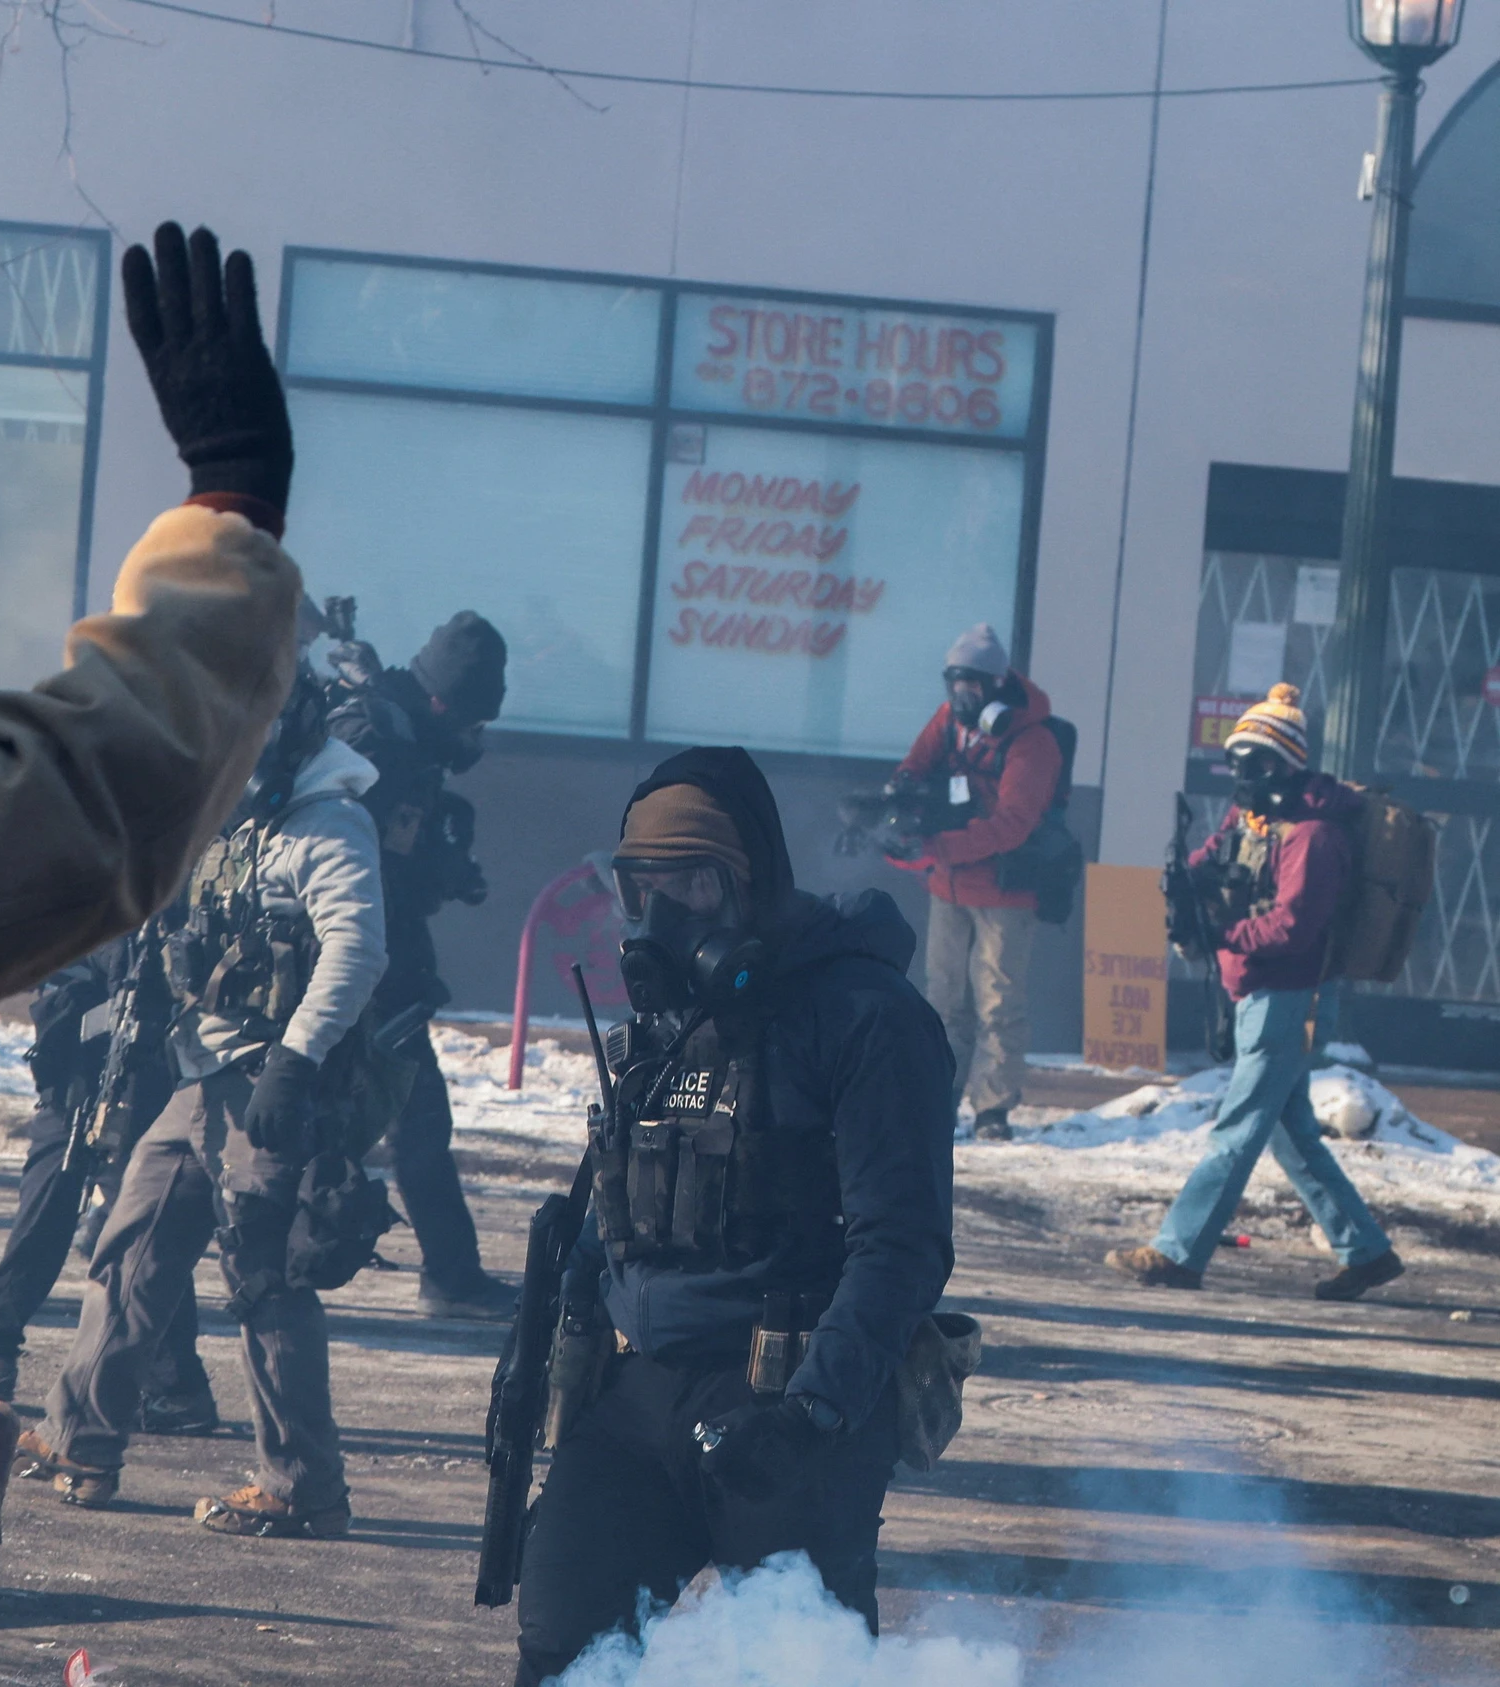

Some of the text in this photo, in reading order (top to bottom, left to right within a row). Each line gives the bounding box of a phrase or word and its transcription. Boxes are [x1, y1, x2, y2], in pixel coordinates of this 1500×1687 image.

[707, 305, 1006, 384] STORE HOURS
[682, 470, 861, 518] MONDAY
[678, 515, 848, 562] FRIDAY
[670, 560, 887, 613] SATURDAY
[668, 607, 847, 657] SUNDAY
[670, 1071, 710, 1092] LICE
